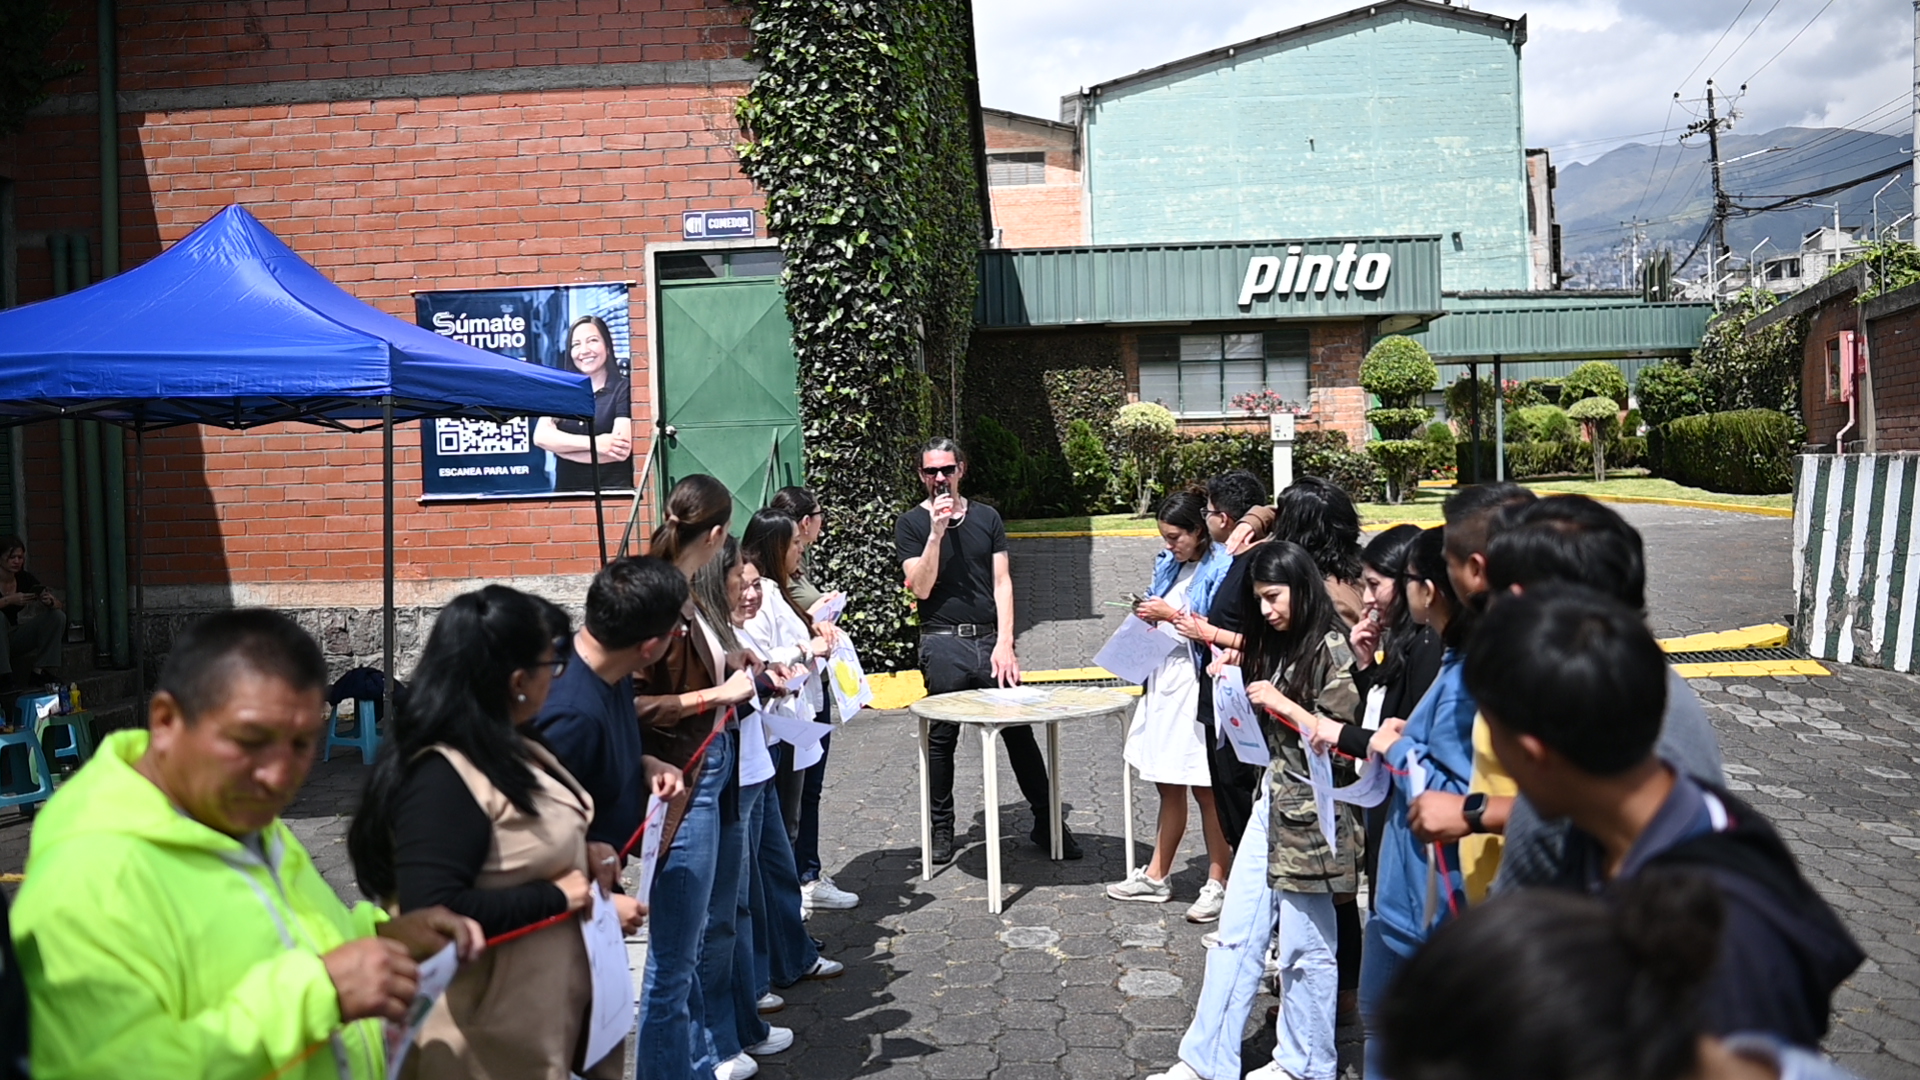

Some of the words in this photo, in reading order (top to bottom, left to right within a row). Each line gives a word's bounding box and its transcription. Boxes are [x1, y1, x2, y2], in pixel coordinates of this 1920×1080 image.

[1237, 243, 1392, 305] pinto
[432, 311, 526, 336] Súmate
[438, 467, 482, 477] ESCANEA
[483, 466, 509, 475] PARA
[509, 465, 530, 475] VER
